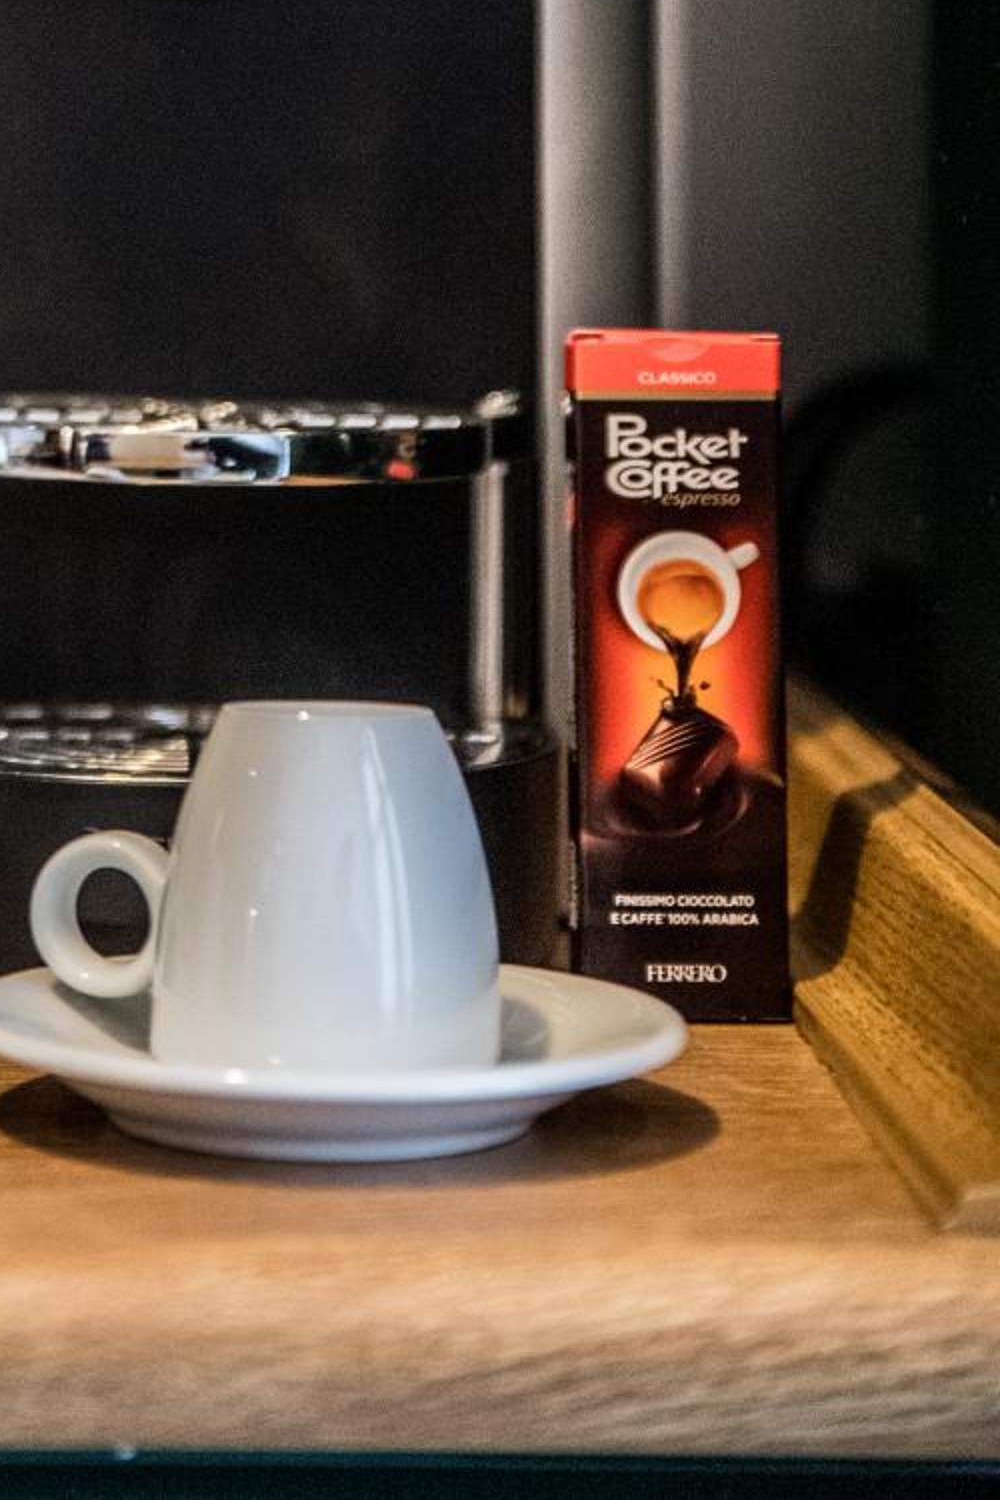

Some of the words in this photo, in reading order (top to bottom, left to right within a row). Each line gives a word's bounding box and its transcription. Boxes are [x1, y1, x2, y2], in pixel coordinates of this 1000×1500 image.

[636, 370, 717, 385] CLASSICO
[605, 412, 748, 465] Pocket
[605, 459, 740, 500] Coffee
[661, 491, 741, 509] espresso
[614, 894, 675, 908] FINISSIMO
[677, 894, 755, 908] CIOCCOLATO
[610, 912, 620, 925] E
[668, 912, 700, 925] 100%
[702, 912, 760, 925] ARABICA
[646, 964, 728, 983] FERRERO
